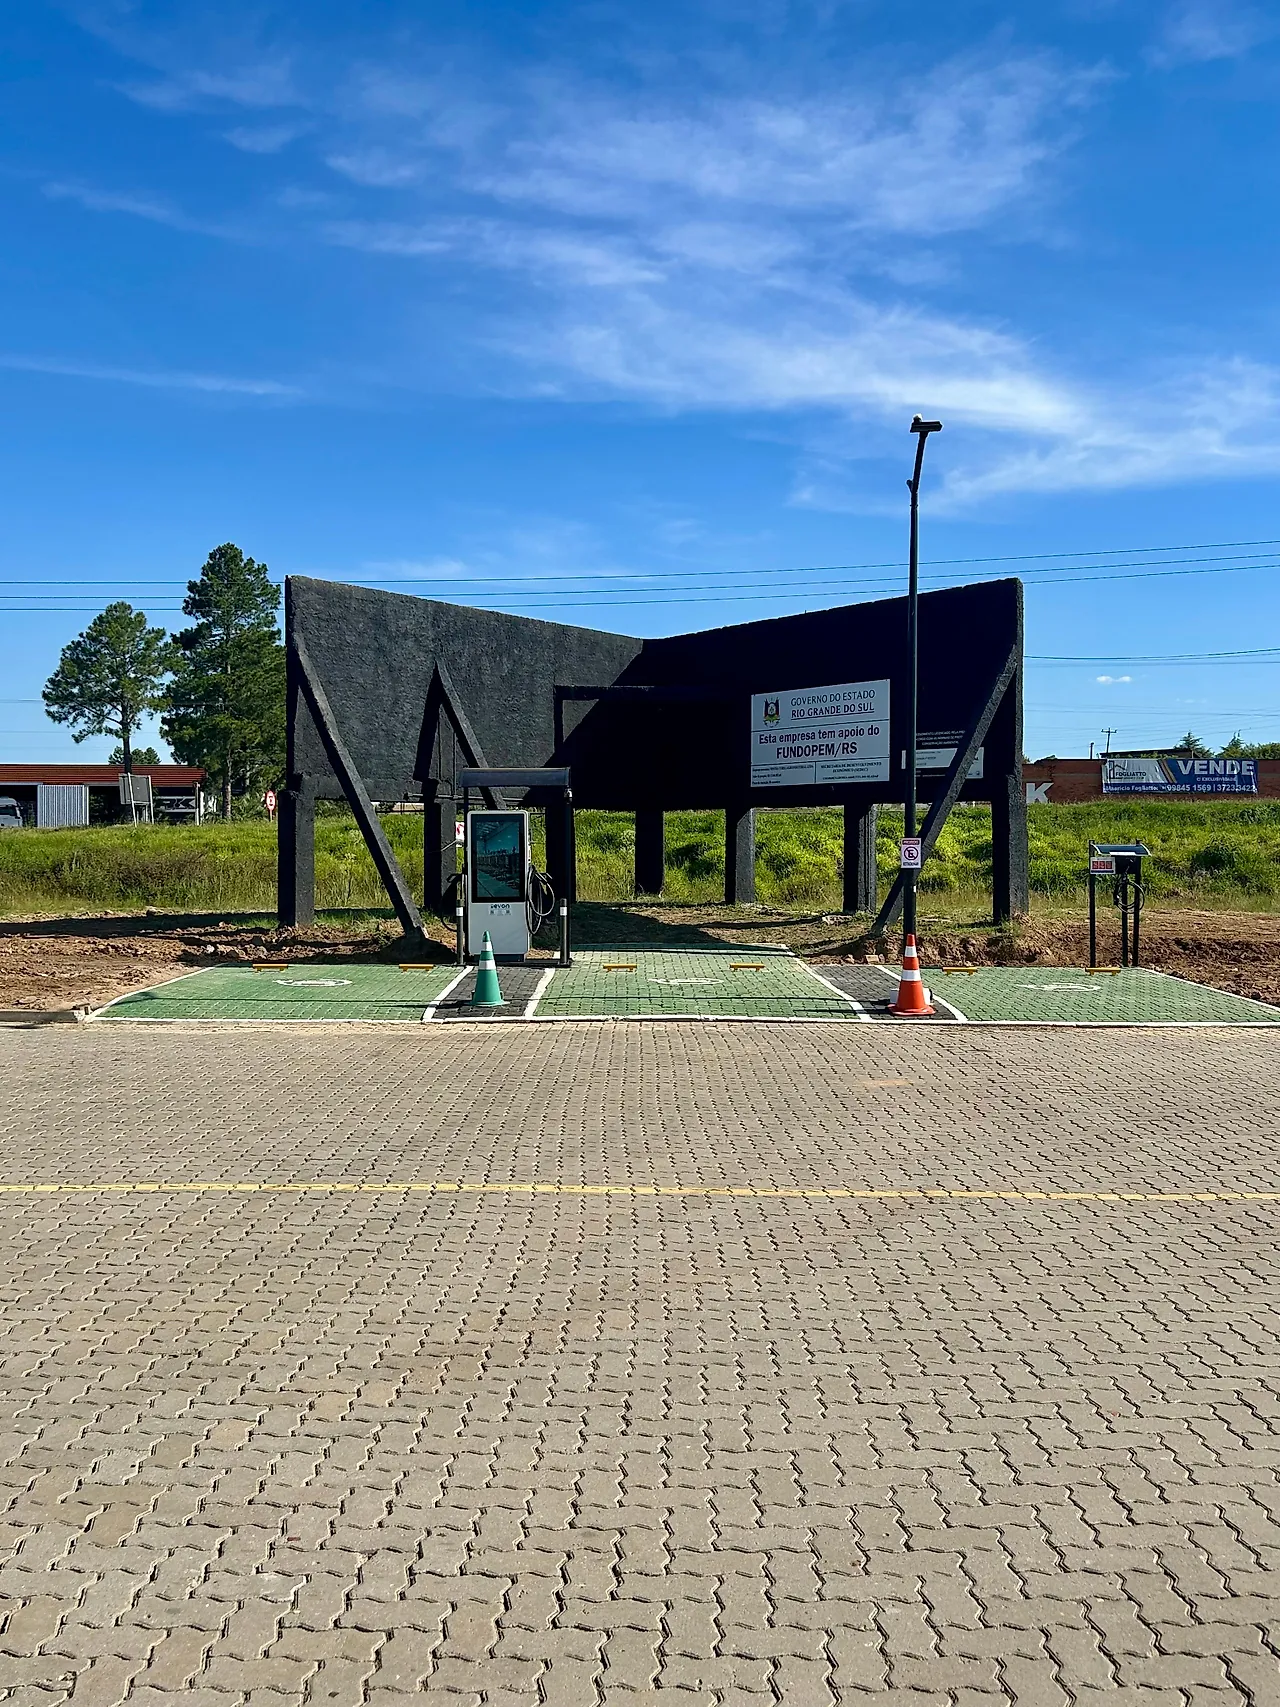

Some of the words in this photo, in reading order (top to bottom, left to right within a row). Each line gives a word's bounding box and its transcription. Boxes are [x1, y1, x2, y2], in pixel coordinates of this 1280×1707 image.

[790, 694, 828, 706] GOVERNO
[829, 692, 841, 702] DO
[842, 689, 876, 700] ESTADO
[791, 708, 806, 718] RIO
[807, 704, 841, 716] GRANDE
[843, 703, 856, 713] DO
[857, 701, 875, 711] SUL
[759, 733, 777, 744] Esta
[779, 731, 816, 744] empresa
[818, 729, 836, 740] tem
[838, 725, 865, 740] apoio
[867, 724, 880, 736] do
[776, 741, 858, 759] FUNDOPEM/RS
[1177, 760, 1255, 775] VENDE
[1192, 784, 1212, 792] 1569
